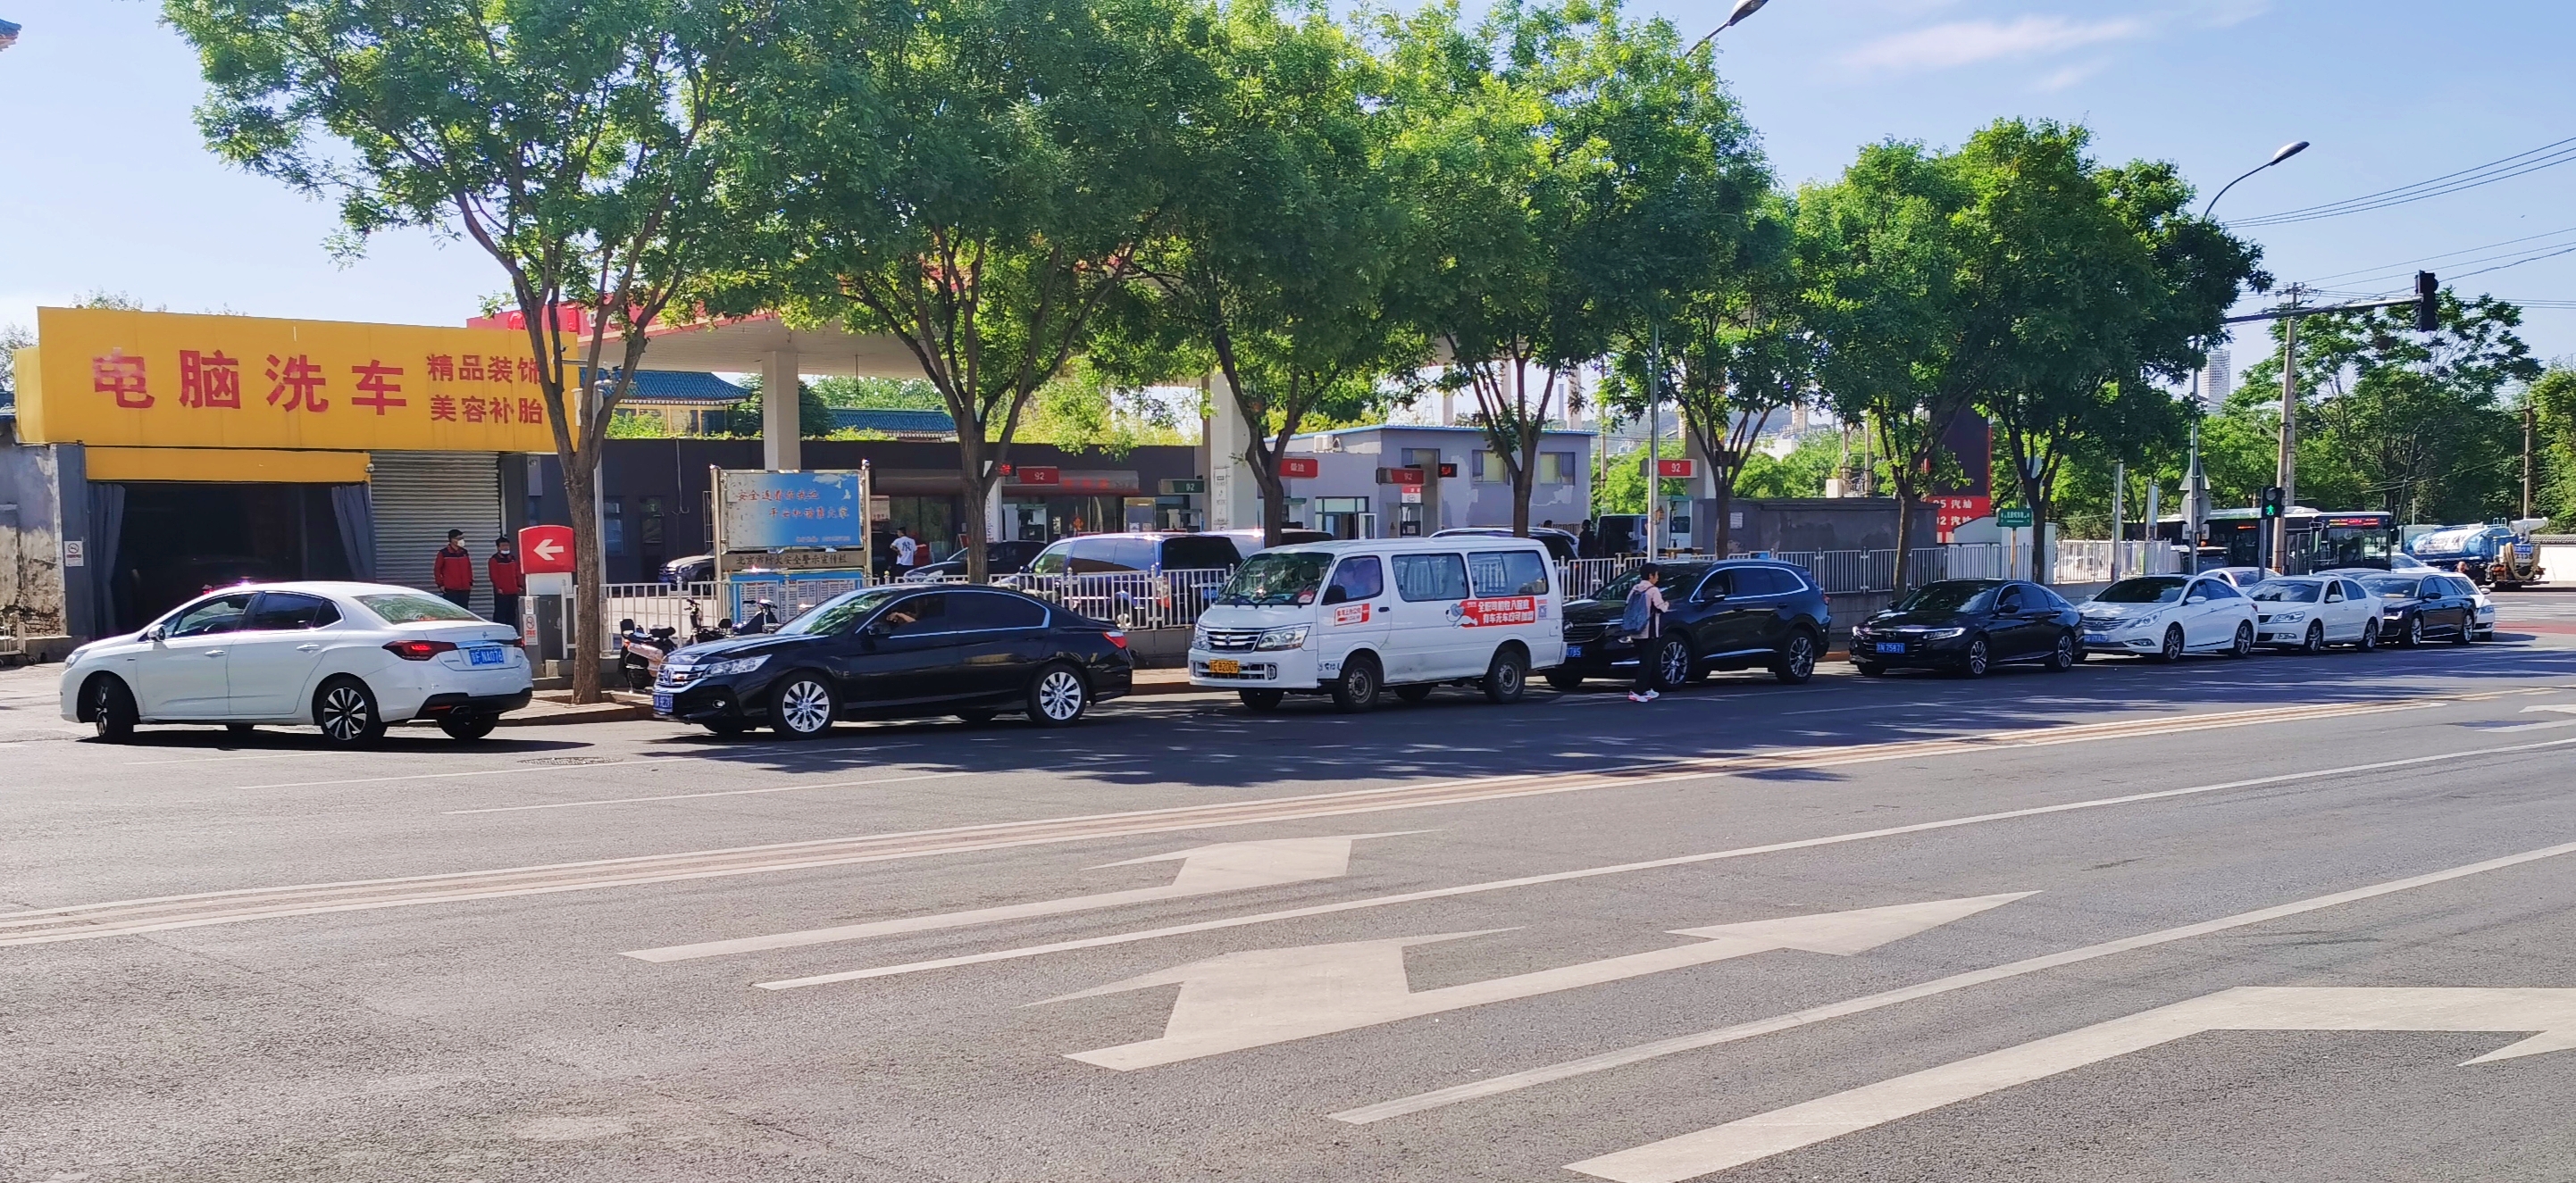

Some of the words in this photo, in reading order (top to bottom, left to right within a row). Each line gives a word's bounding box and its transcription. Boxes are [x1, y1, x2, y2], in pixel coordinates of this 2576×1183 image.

[427, 354, 540, 384] 精品装饰
[93, 348, 406, 415] 电脑洗车
[431, 395, 543, 424] 美容补胎
[1671, 463, 1681, 472] 92
[1034, 472, 1045, 480] 92
[1951, 499, 1972, 509] 汽油
[737, 554, 848, 565] 北京市防火安全警示宣传栏
